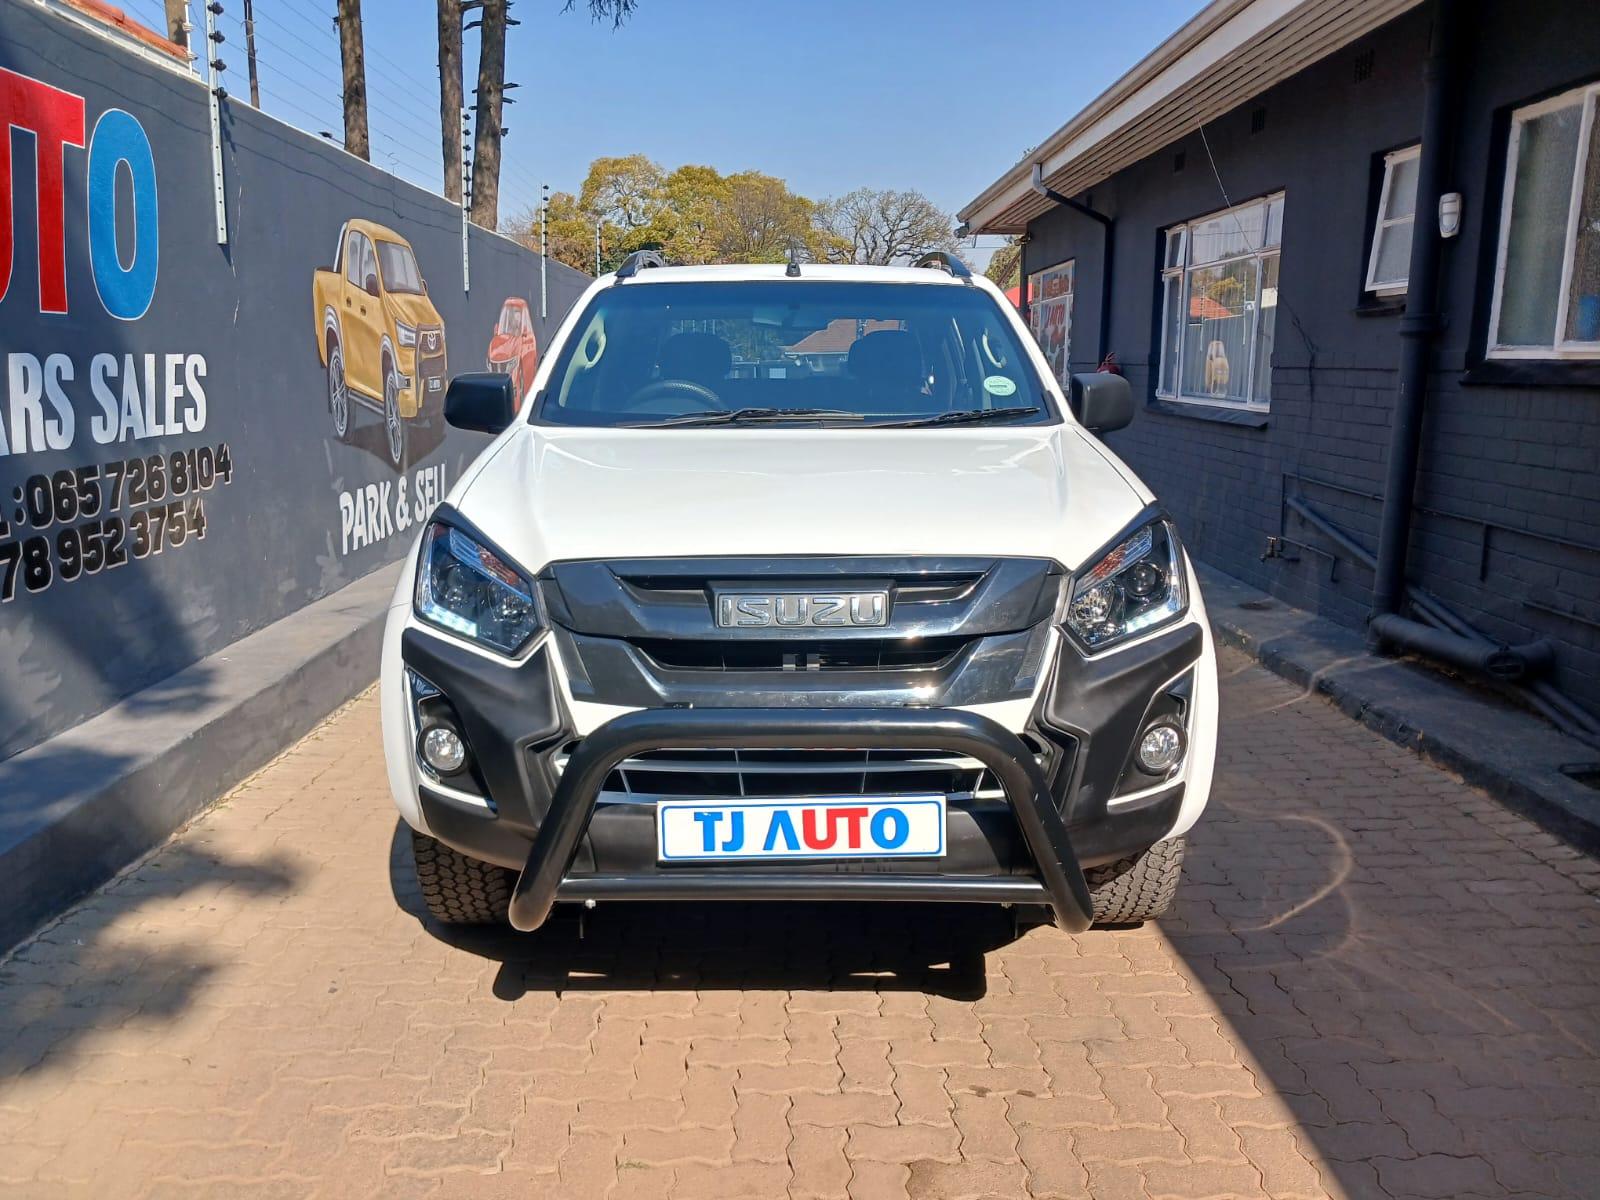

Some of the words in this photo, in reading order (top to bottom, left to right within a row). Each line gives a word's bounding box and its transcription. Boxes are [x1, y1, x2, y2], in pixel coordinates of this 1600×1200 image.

[0, 353, 76, 456] RS
[90, 353, 207, 444] SALES
[105, 455, 166, 507] 726
[169, 442, 233, 497] 8104
[57, 517, 128, 582] 952
[130, 497, 206, 559] 3754
[339, 481, 393, 555] PARK
[395, 475, 412, 532] &
[722, 597, 884, 627] ISUZU
[694, 811, 745, 852] TJ
[763, 807, 910, 851] AUTO
